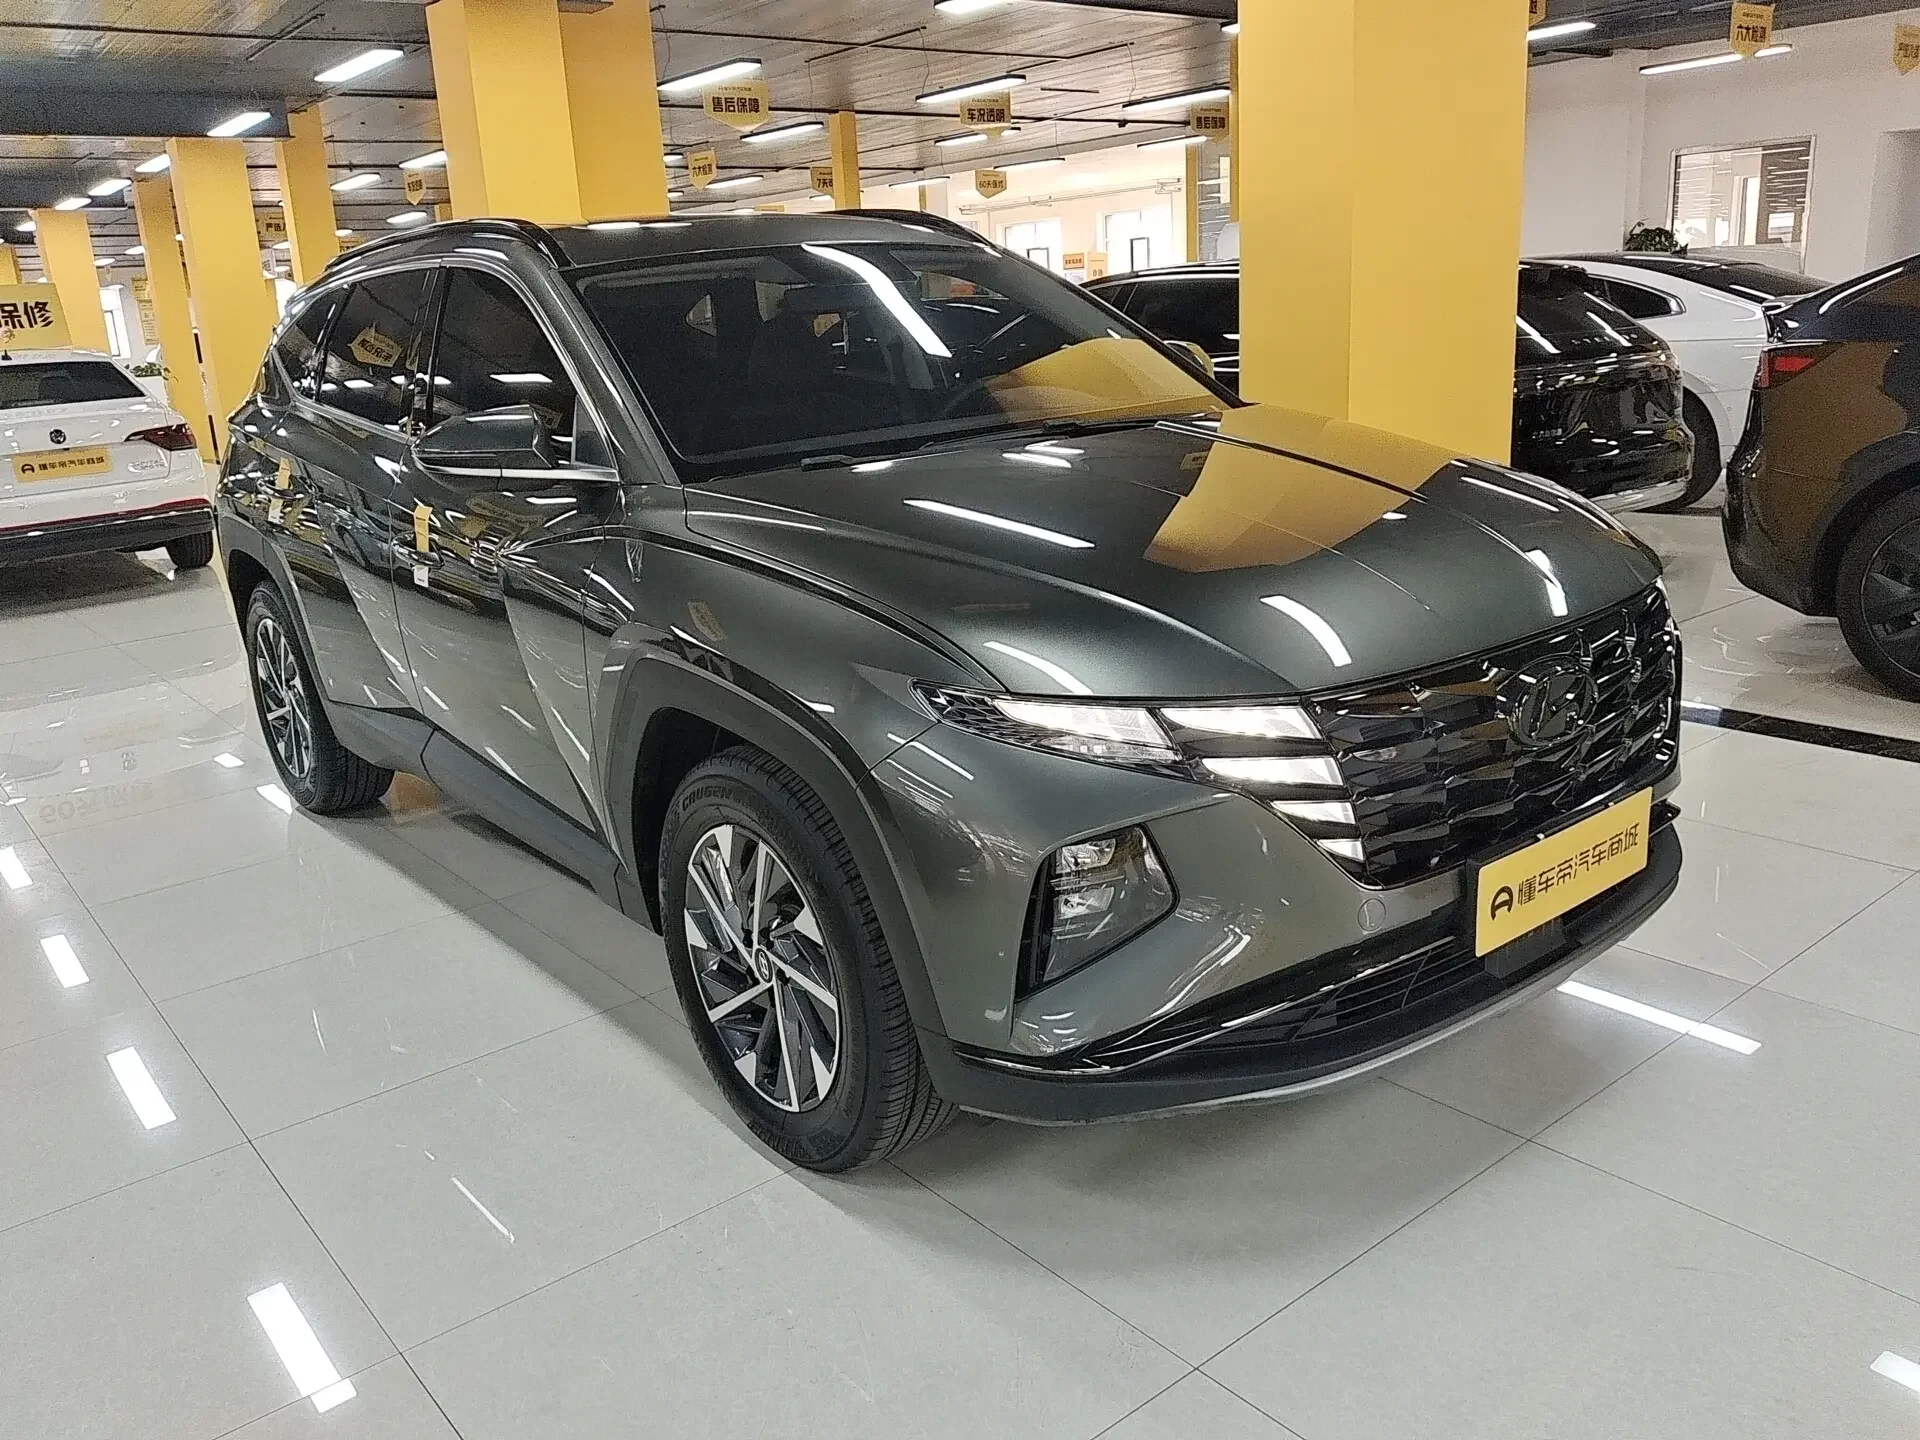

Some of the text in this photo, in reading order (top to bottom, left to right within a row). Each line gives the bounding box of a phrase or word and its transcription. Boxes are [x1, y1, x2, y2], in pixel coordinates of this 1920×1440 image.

[712, 96, 760, 113] 售后保障
[967, 108, 1005, 122] 车况透明
[1196, 116, 1225, 129] 售后保障
[1517, 821, 1640, 906] 懂车帝汽车商城
